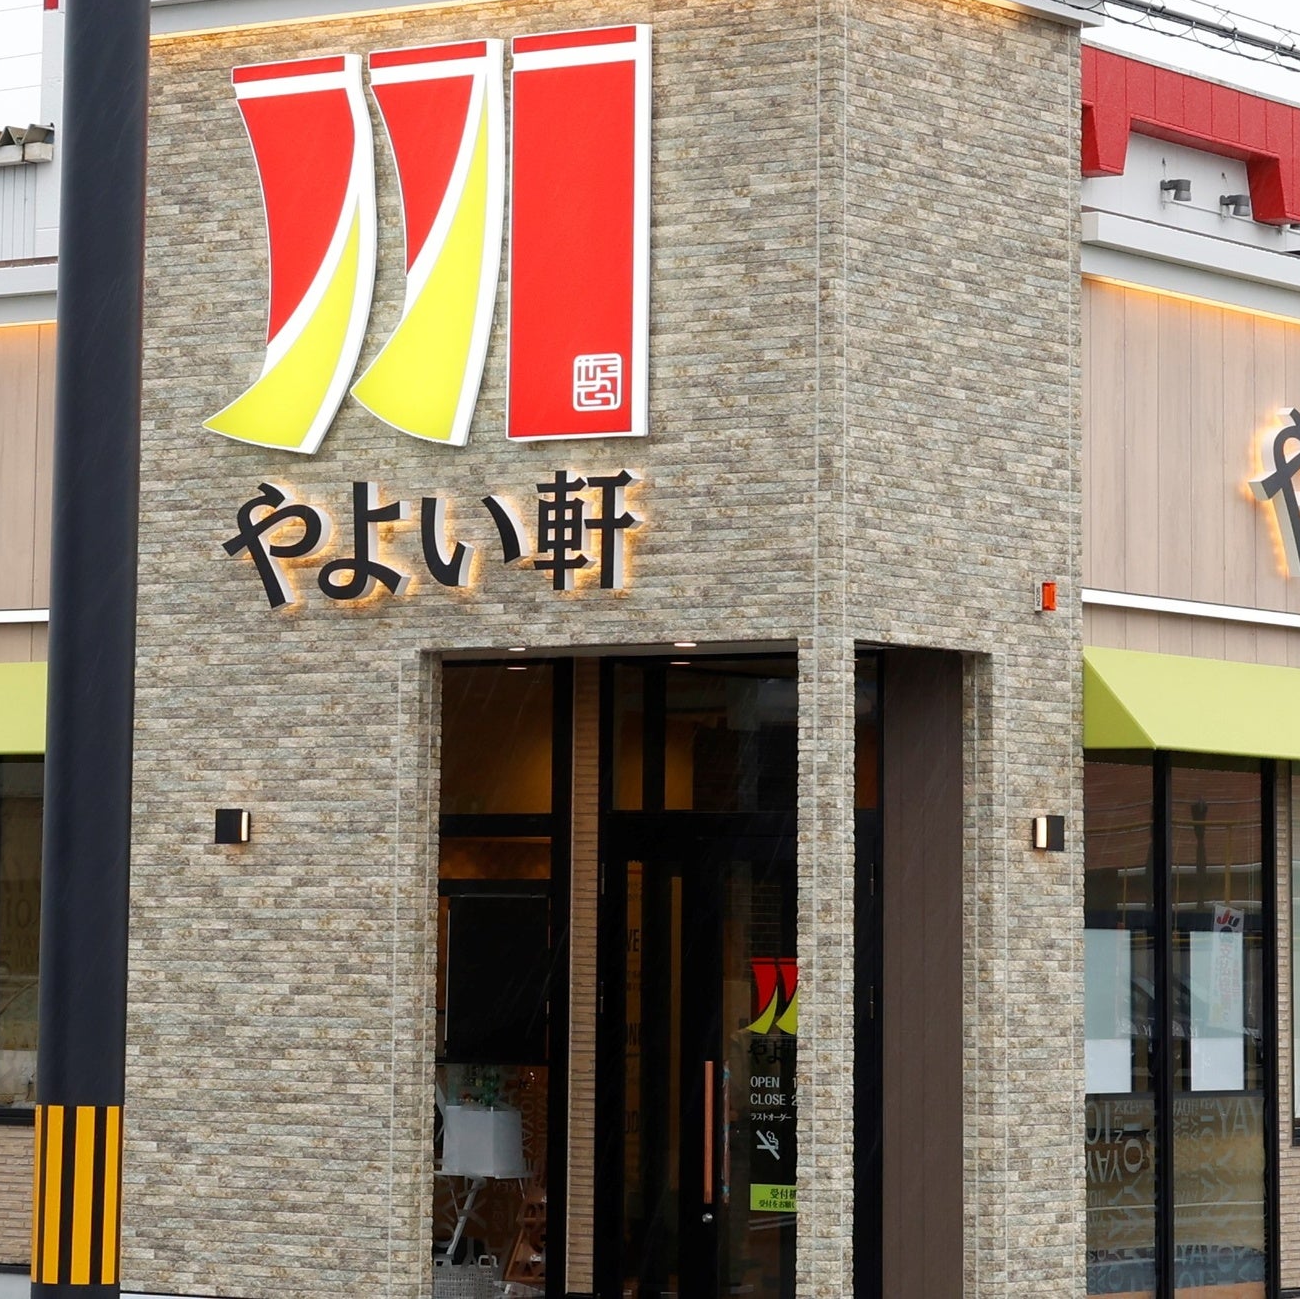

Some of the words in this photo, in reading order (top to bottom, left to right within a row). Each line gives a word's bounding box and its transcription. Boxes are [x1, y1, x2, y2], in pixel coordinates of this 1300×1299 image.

[221, 469, 638, 610] やよい軒
[750, 1076, 780, 1088] OPEN
[750, 1093, 787, 1106] CLOSE
[750, 1112, 792, 1121] ラストオーダー
